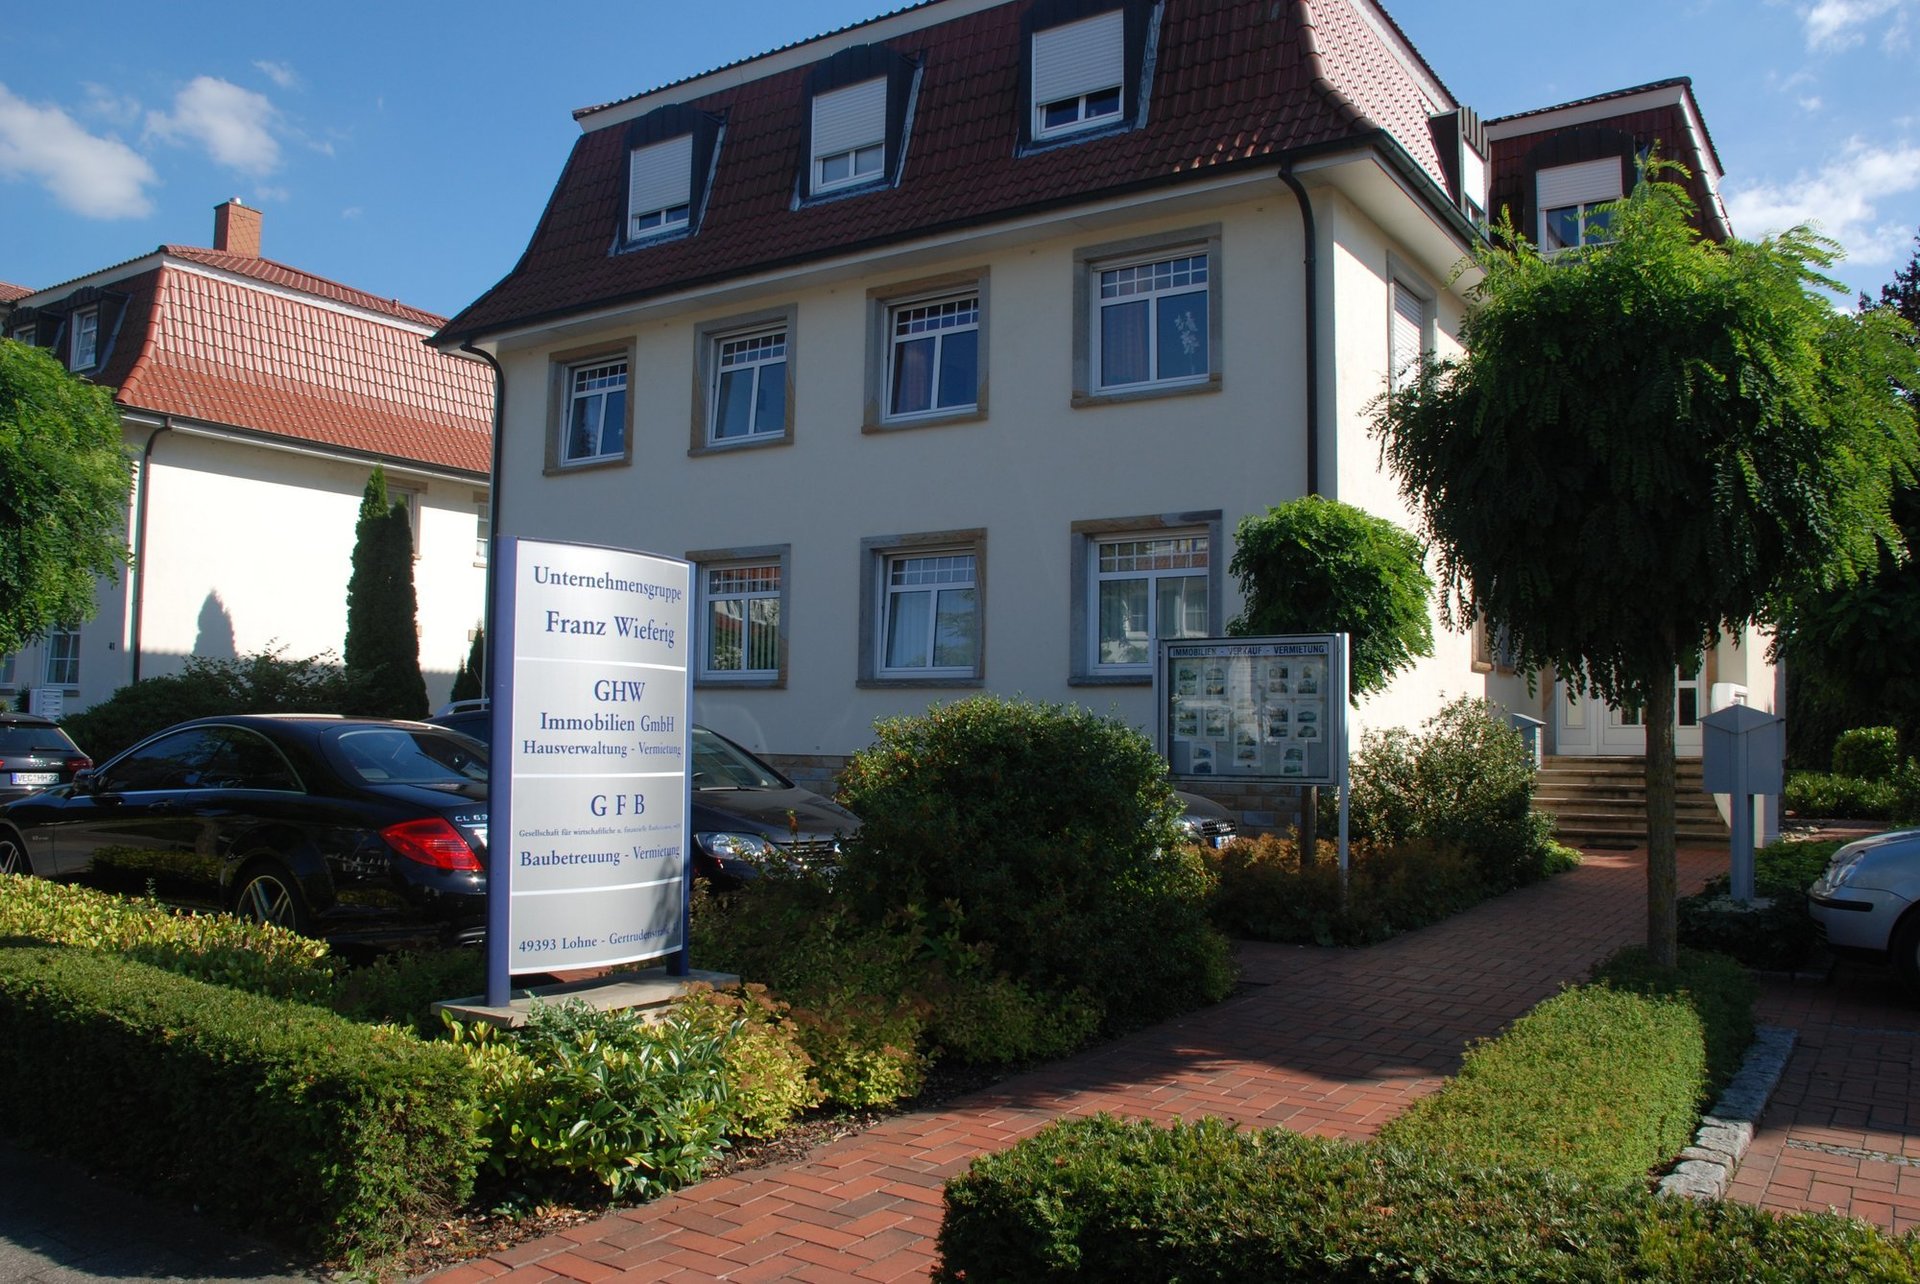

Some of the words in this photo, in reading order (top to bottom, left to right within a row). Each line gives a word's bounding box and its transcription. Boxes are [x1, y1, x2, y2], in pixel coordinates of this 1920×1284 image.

[533, 565, 682, 603] Unternehmensgruppe
[545, 610, 607, 636] Franz
[613, 615, 675, 649] Wieferig
[1172, 647, 1217, 657] IMMOBILIEN
[1273, 644, 1325, 655] VERMIETUNG
[593, 679, 646, 702] GHW
[540, 711, 635, 732] Immobilien
[640, 714, 674, 732] GmbH
[523, 739, 628, 758] Hausverwaltung
[638, 741, 682, 758] Vermietung
[518, 828, 560, 838] Gesellschaft
[561, 828, 572, 836] für
[520, 849, 620, 867] Baubetreuung
[633, 844, 680, 859] Vermietung
[518, 939, 557, 952] 49393
[562, 937, 598, 950] Lohne
